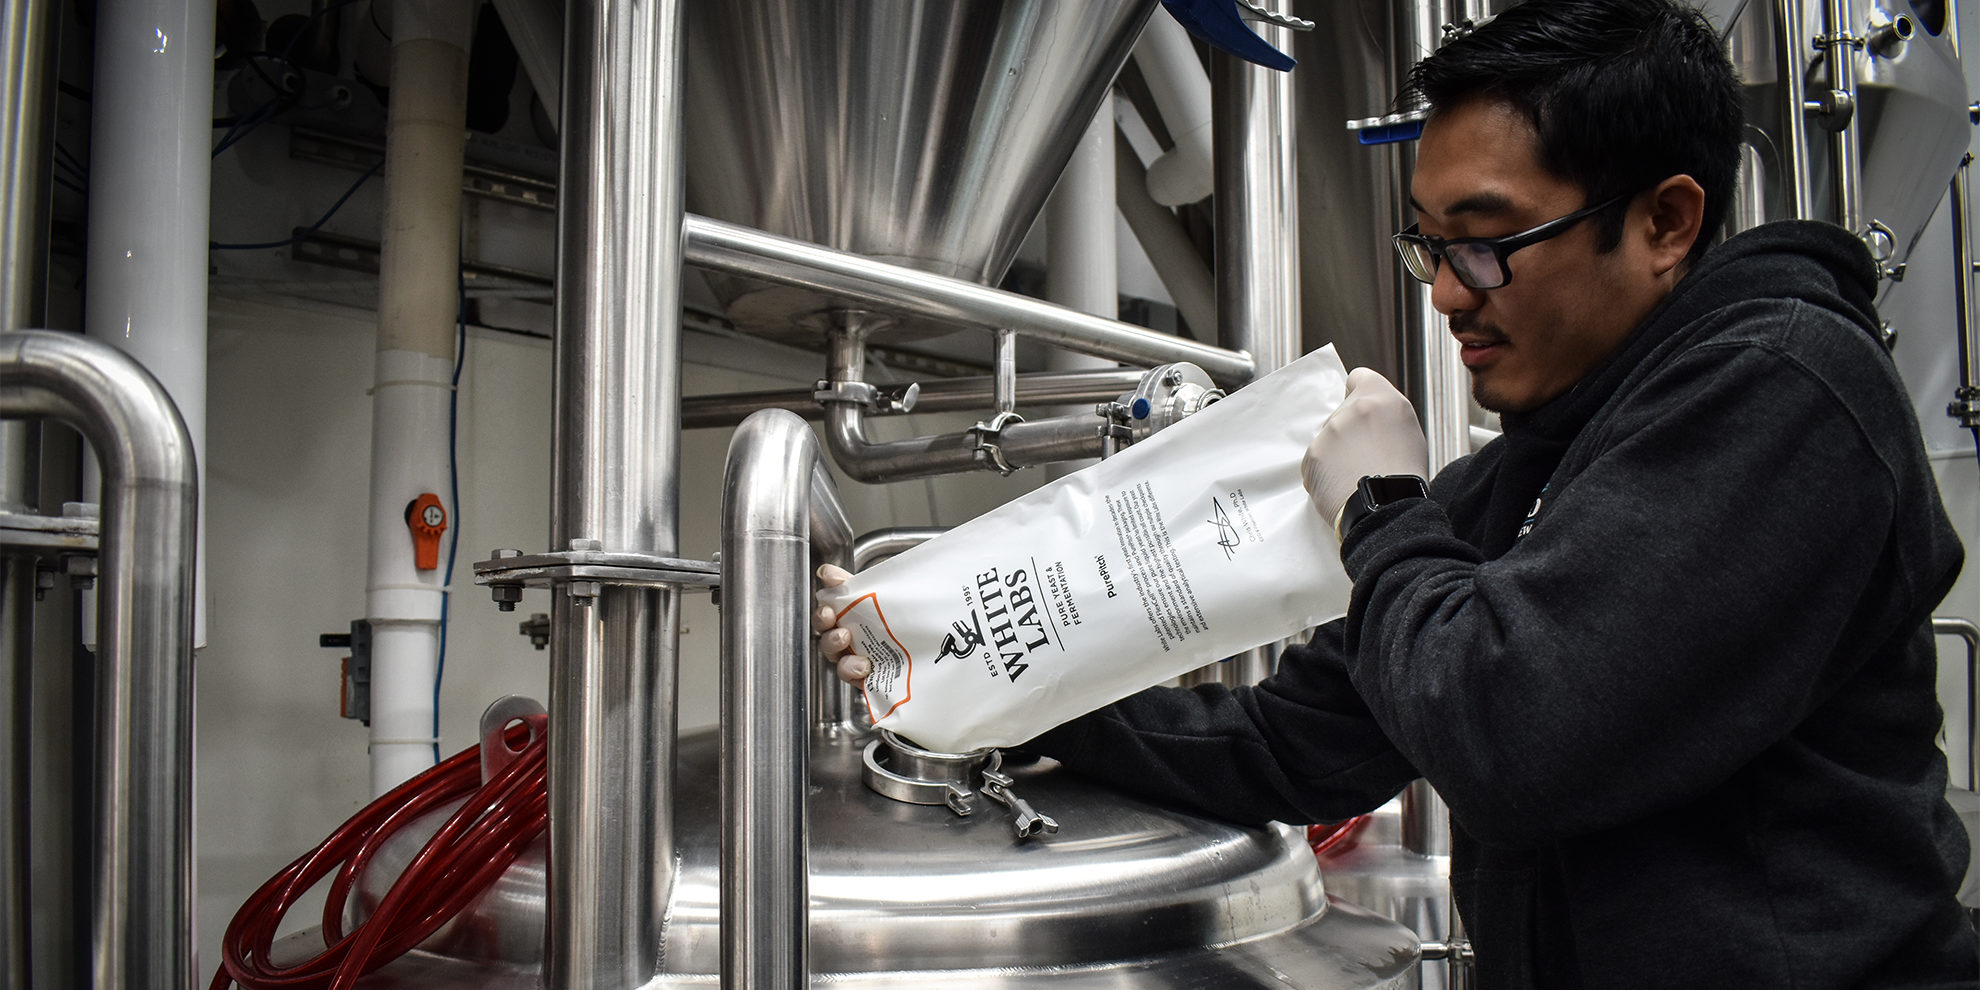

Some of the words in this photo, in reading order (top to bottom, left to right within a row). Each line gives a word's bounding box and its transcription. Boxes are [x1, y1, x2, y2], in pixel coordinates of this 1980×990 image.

[1153, 531, 1164, 553] through
[1047, 574, 1059, 599] YEAST
[1055, 561, 1081, 625] FERMENTATION
[1158, 589, 1168, 607] ensure
[1172, 580, 1186, 604] standard
[1005, 569, 1050, 653] LABS
[1055, 601, 1070, 626] PURE
[1146, 608, 1156, 623] offers
[1168, 591, 1186, 626] environment
[1189, 596, 1203, 621] extensive
[976, 567, 1029, 682] WHITE
[1154, 624, 1162, 637] Labs
[1158, 616, 1174, 639] patented
[983, 652, 998, 677] ESTD
